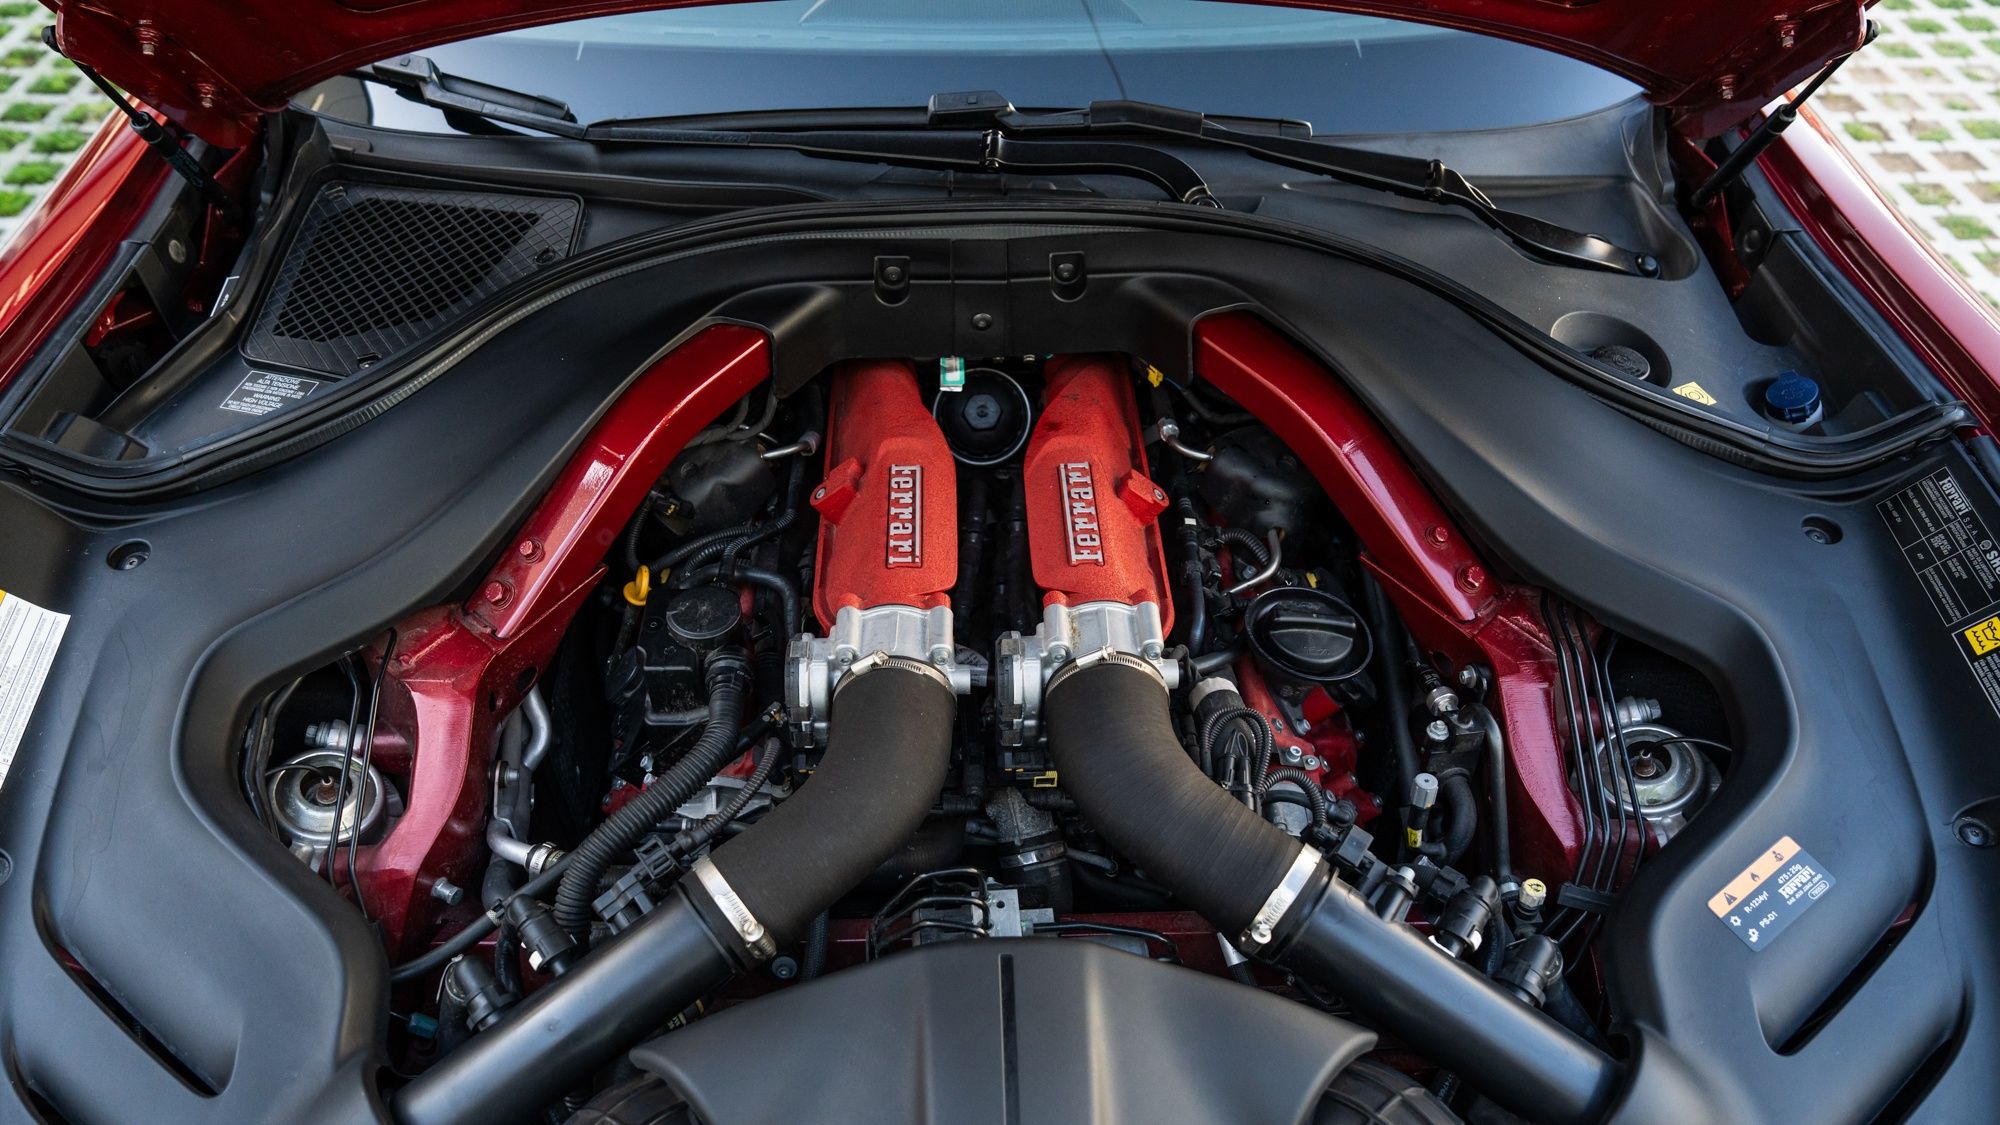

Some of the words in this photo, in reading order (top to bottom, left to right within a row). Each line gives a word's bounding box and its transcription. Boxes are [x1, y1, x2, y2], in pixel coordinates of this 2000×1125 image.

[253, 393, 281, 402] WARNING
[258, 398, 284, 408] VOLTAGE
[1939, 477, 1971, 515] Ferrari
[888, 464, 921, 564] Ferrari
[1060, 462, 1103, 564] Ferrari
[1778, 866, 1816, 899] Ferrari
[1744, 891, 1768, 913] R-1234yf
